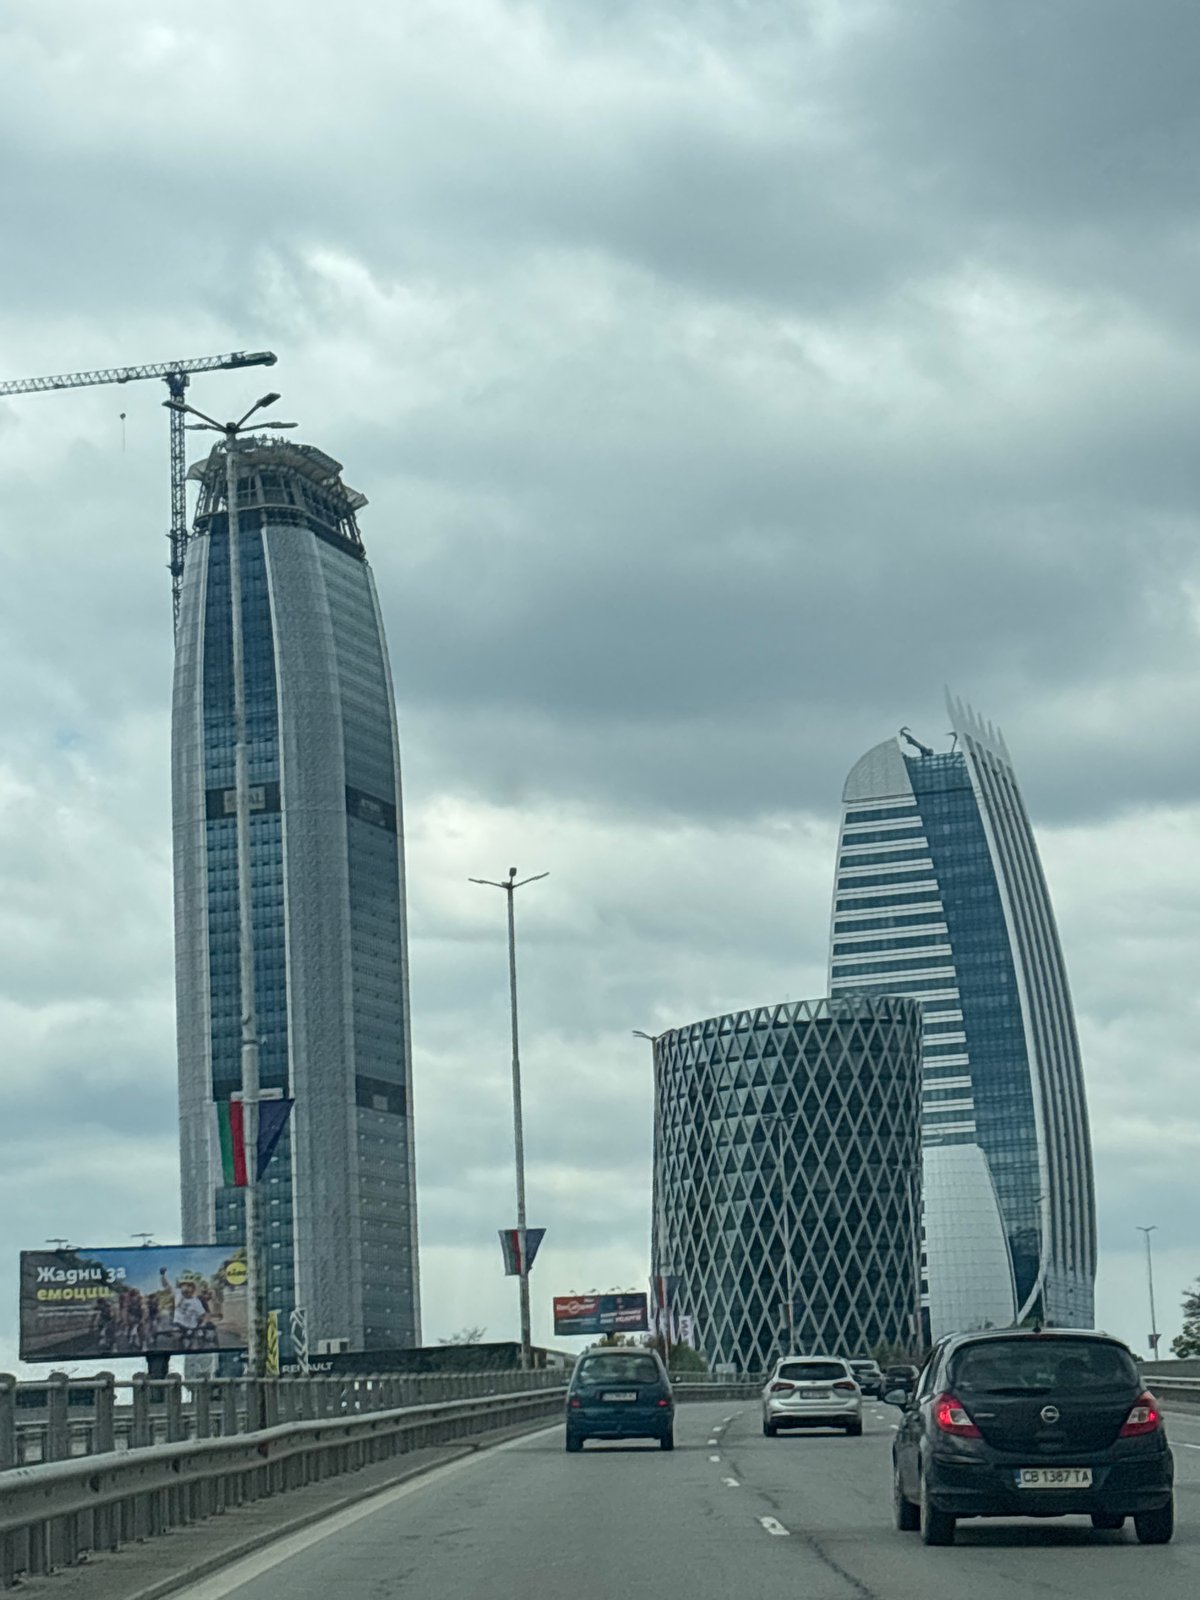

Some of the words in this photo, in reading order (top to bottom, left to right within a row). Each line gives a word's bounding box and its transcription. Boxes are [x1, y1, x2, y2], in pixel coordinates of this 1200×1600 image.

[37, 1267, 102, 1284] Жадни
[106, 1267, 126, 1283] за
[1023, 1471, 1039, 1482] CB
[1042, 1470, 1070, 1482] 1387
[1074, 1470, 1090, 1481] TA
